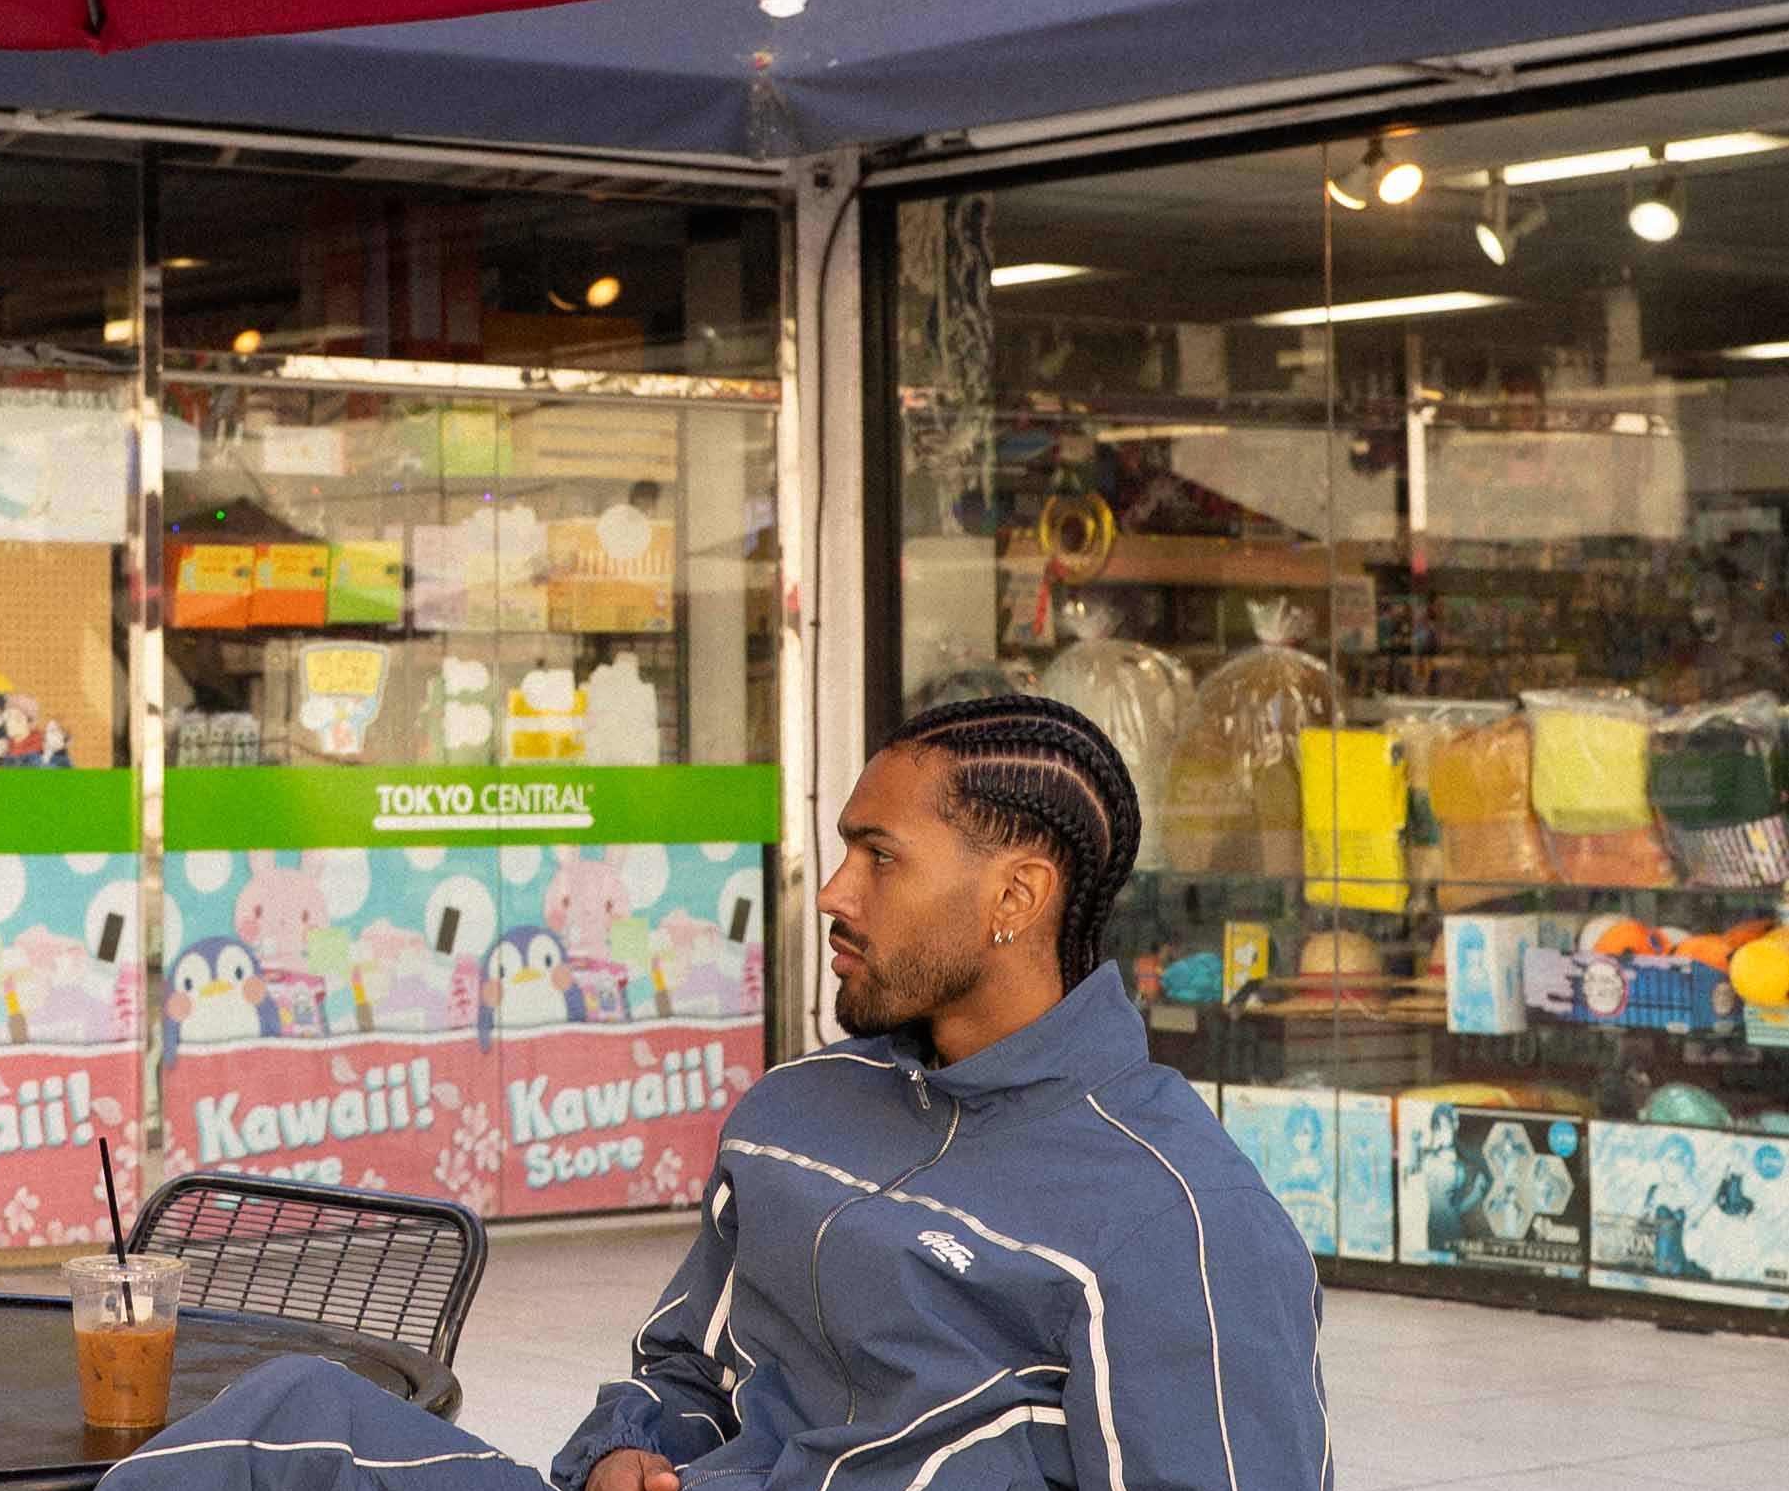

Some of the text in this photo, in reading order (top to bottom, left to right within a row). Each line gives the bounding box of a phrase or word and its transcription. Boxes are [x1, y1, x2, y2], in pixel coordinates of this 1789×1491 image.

[376, 784, 590, 814] TOKYO CENTRAL
[195, 1057, 436, 1164] Kawaii!
[509, 1042, 728, 1146] Kawaii!
[523, 1136, 645, 1191] Store
